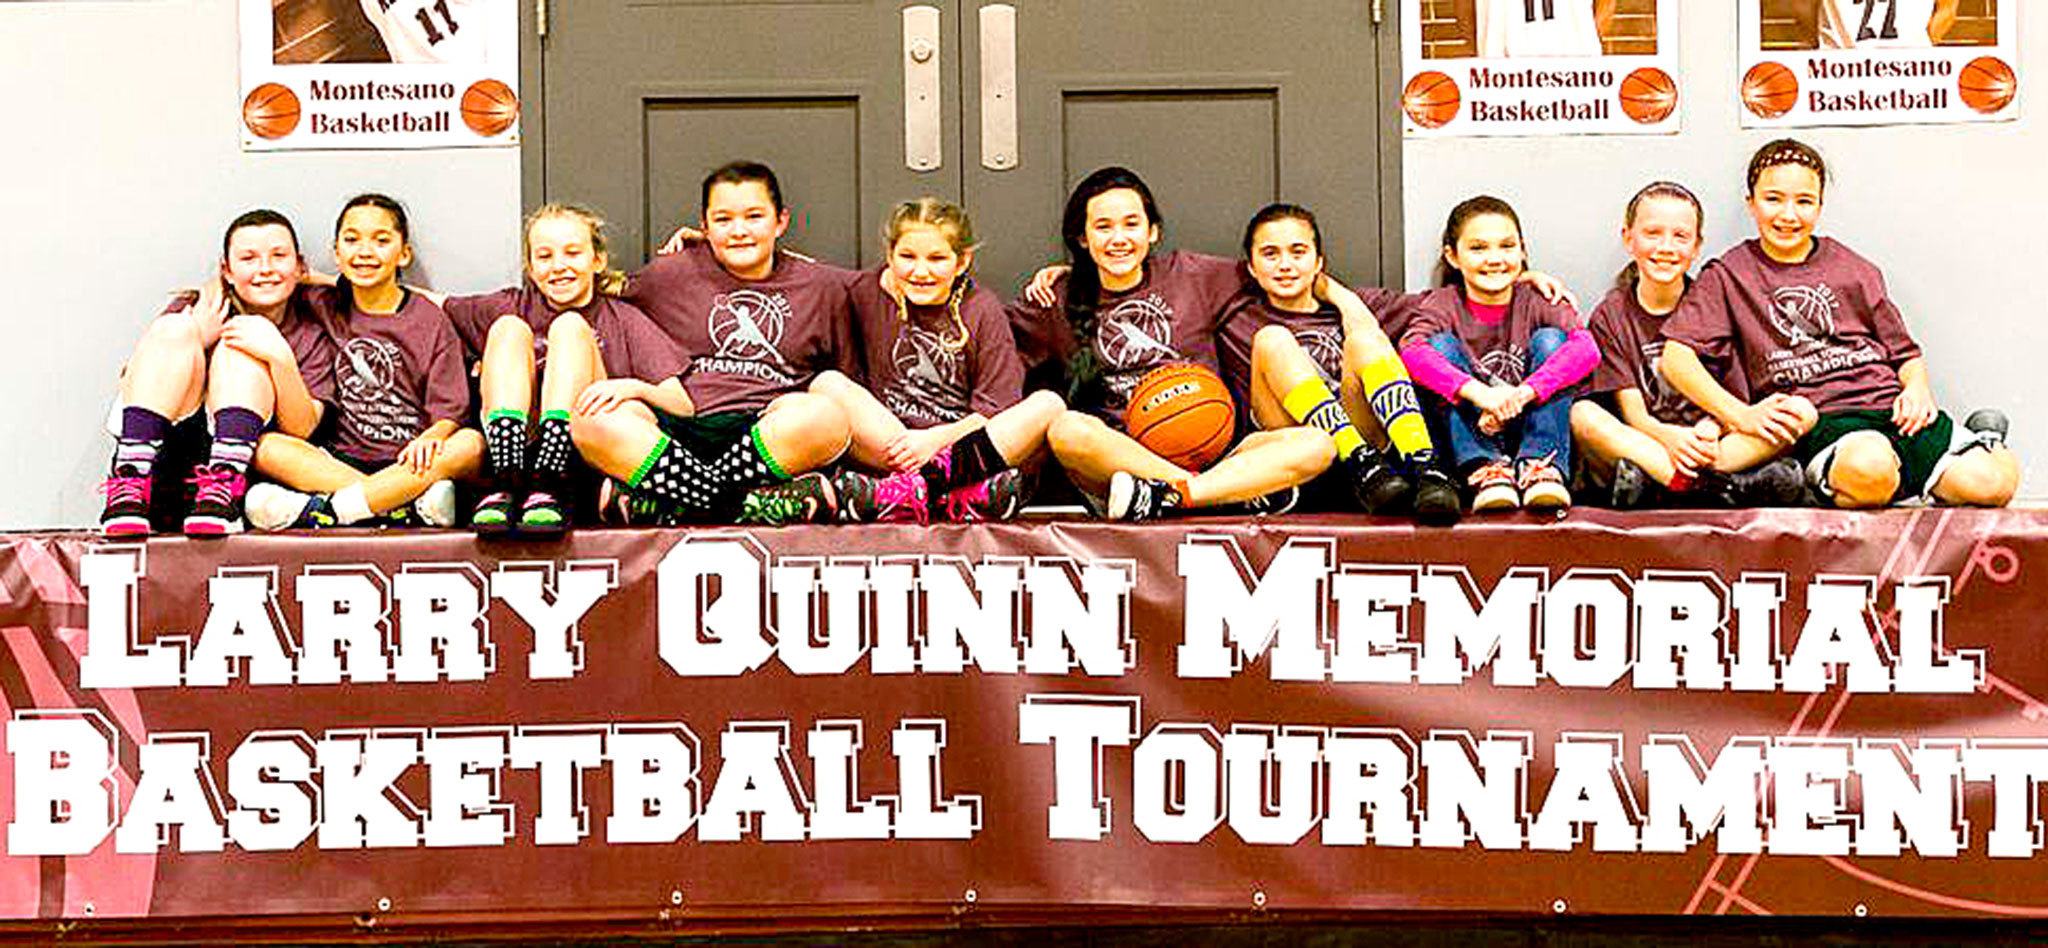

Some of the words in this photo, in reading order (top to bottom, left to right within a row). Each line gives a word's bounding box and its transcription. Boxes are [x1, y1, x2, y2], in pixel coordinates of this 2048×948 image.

[1469, 67, 1614, 89] Montesano
[1807, 57, 1953, 79] Montesano
[309, 79, 455, 101] Montesano
[1808, 87, 1948, 112] Basketball
[1470, 99, 1610, 122] Basketball
[310, 111, 450, 135] Basketball
[80, 543, 619, 689] LARRY
[656, 530, 1137, 678] QUINN
[1176, 533, 1986, 693] MEMORIAL
[6, 708, 983, 856] BASKETBALL
[1018, 692, 2048, 859] TOURNAMENT
